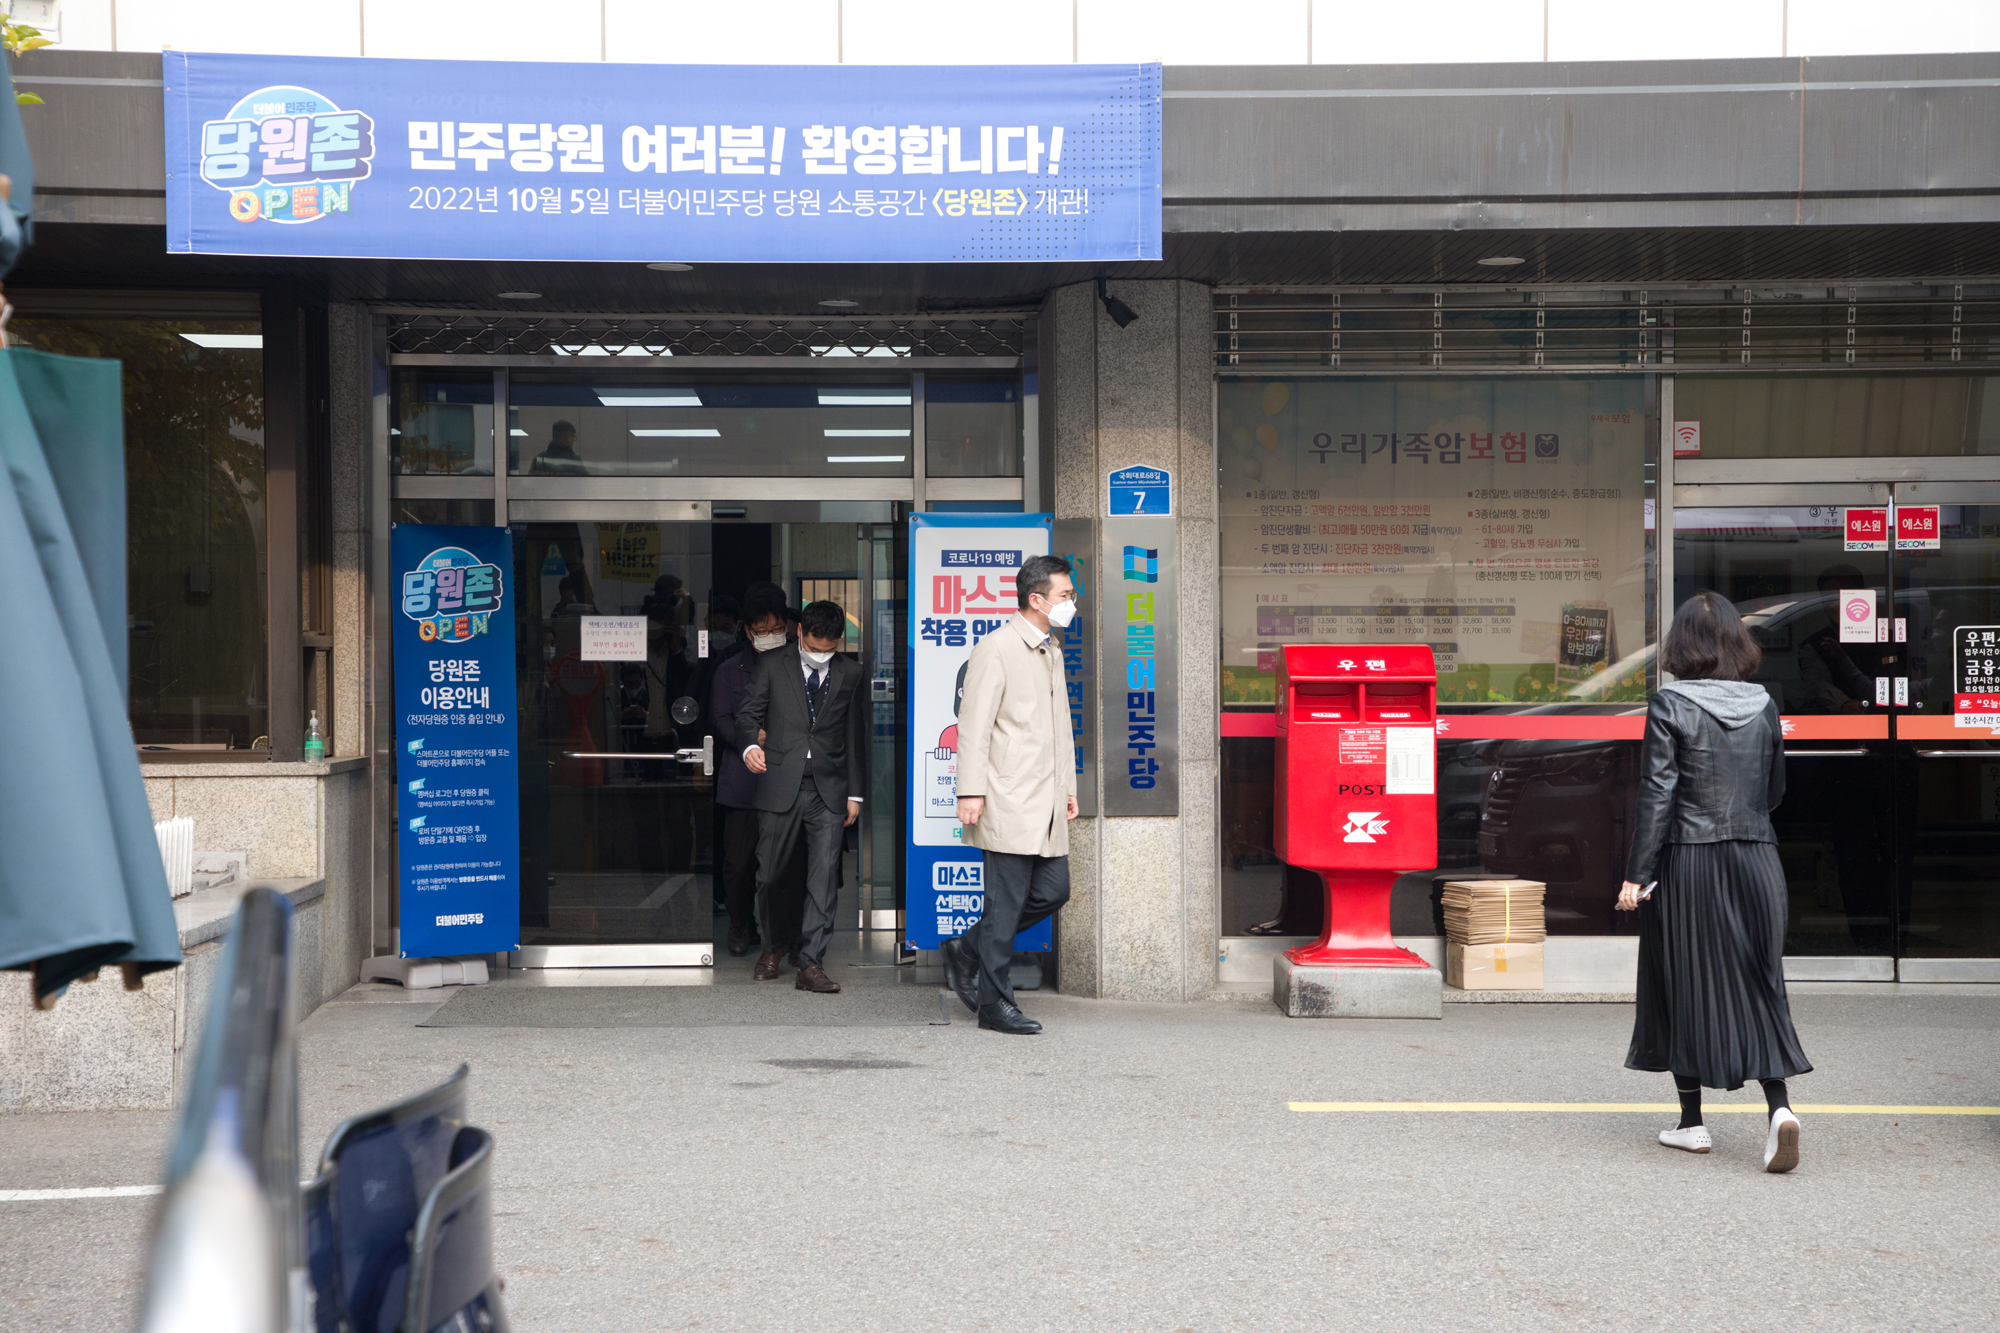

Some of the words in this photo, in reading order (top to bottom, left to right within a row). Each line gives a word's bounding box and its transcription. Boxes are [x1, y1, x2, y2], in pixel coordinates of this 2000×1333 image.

[254, 101, 317, 116] 더불어민주당
[204, 115, 360, 179] 당원존
[408, 121, 604, 173] 민주당원
[622, 124, 786, 176] 여러분!
[802, 125, 1064, 176] 환영합니다!
[229, 183, 350, 222] OPEN
[408, 186, 498, 212] 2022년
[508, 187, 562, 214] 10월
[570, 188, 609, 215] 5일
[618, 188, 766, 216] 더불어민주당
[773, 188, 820, 216] 당원
[828, 188, 926, 216] 소통공간
[1035, 188, 1089, 216] 개관!
[1611, 413, 1631, 423] 보험
[1308, 432, 1526, 464] 우리가족암보험
[1118, 472, 1160, 480] 국회대로68길
[1254, 490, 1290, 500] 1종(일반,
[1292, 490, 1320, 500] 갱신형)
[1474, 489, 1511, 499] 2종(일반,
[1134, 492, 1146, 510] 7
[1261, 505, 1302, 517] 암진단자금
[1310, 505, 1335, 517] 고액암
[1337, 505, 1370, 517] 6천만원,
[1373, 505, 1398, 517] 일반암
[1400, 505, 1431, 517] 3천만원
[1474, 509, 1519, 519] 3종(실버형,
[1522, 509, 1550, 519] 갱신형)
[1261, 524, 1310, 536] 암진단생활비
[1318, 524, 1357, 536] (최고)매월
[1360, 524, 1387, 536] 50만원
[1390, 524, 1409, 536] 60회
[1482, 525, 1514, 534] 61~80세
[1517, 525, 1533, 534] 가입
[1851, 520, 1881, 532] 에스원
[1902, 518, 1932, 530] 에스원
[1482, 538, 1508, 548] 고혈압,
[1511, 538, 1535, 548] 당뇨병
[1538, 538, 1561, 548] 무심사
[1564, 538, 1580, 548] 가입
[1261, 544, 1269, 555] 두
[1272, 544, 1289, 555] 번째
[1292, 544, 1300, 555] 암
[1303, 544, 1328, 555] 진단시
[1335, 544, 1368, 555] 진단자금
[948, 553, 992, 565] 코로나19
[995, 553, 1015, 565] 예방
[1261, 563, 1286, 574] 소액암
[1289, 563, 1314, 574] 진단시
[1322, 563, 1339, 574] 최대
[1520, 571, 1536, 581] 또는
[1540, 571, 1562, 581] 100세
[1565, 571, 1580, 581] 만기
[1583, 571, 1602, 581] 선택)
[405, 566, 494, 613] 당원존
[419, 614, 489, 642] OPEN
[921, 618, 967, 646] 착용
[1966, 632, 2000, 647] 우편
[1568, 642, 1598, 656] 암보험!
[429, 660, 480, 682] 당원존
[1337, 660, 1386, 671] 우편
[1966, 659, 2000, 676] 금융
[1126, 592, 1160, 790] 더불어민주당
[421, 687, 489, 710] 이용안내
[450, 714, 466, 725] 인증
[468, 714, 483, 725] 출입
[451, 750, 484, 758] 더불어민주당
[417, 759, 450, 767] 더불어민주당
[937, 776, 951, 785] 전염
[1339, 784, 1386, 795] POST
[932, 798, 954, 806] 마스크
[418, 827, 429, 835] 로비
[431, 826, 453, 834] 단말기에
[475, 835, 487, 843] 입장
[938, 866, 981, 886] 마스크
[436, 913, 484, 926] 더불어민주당
